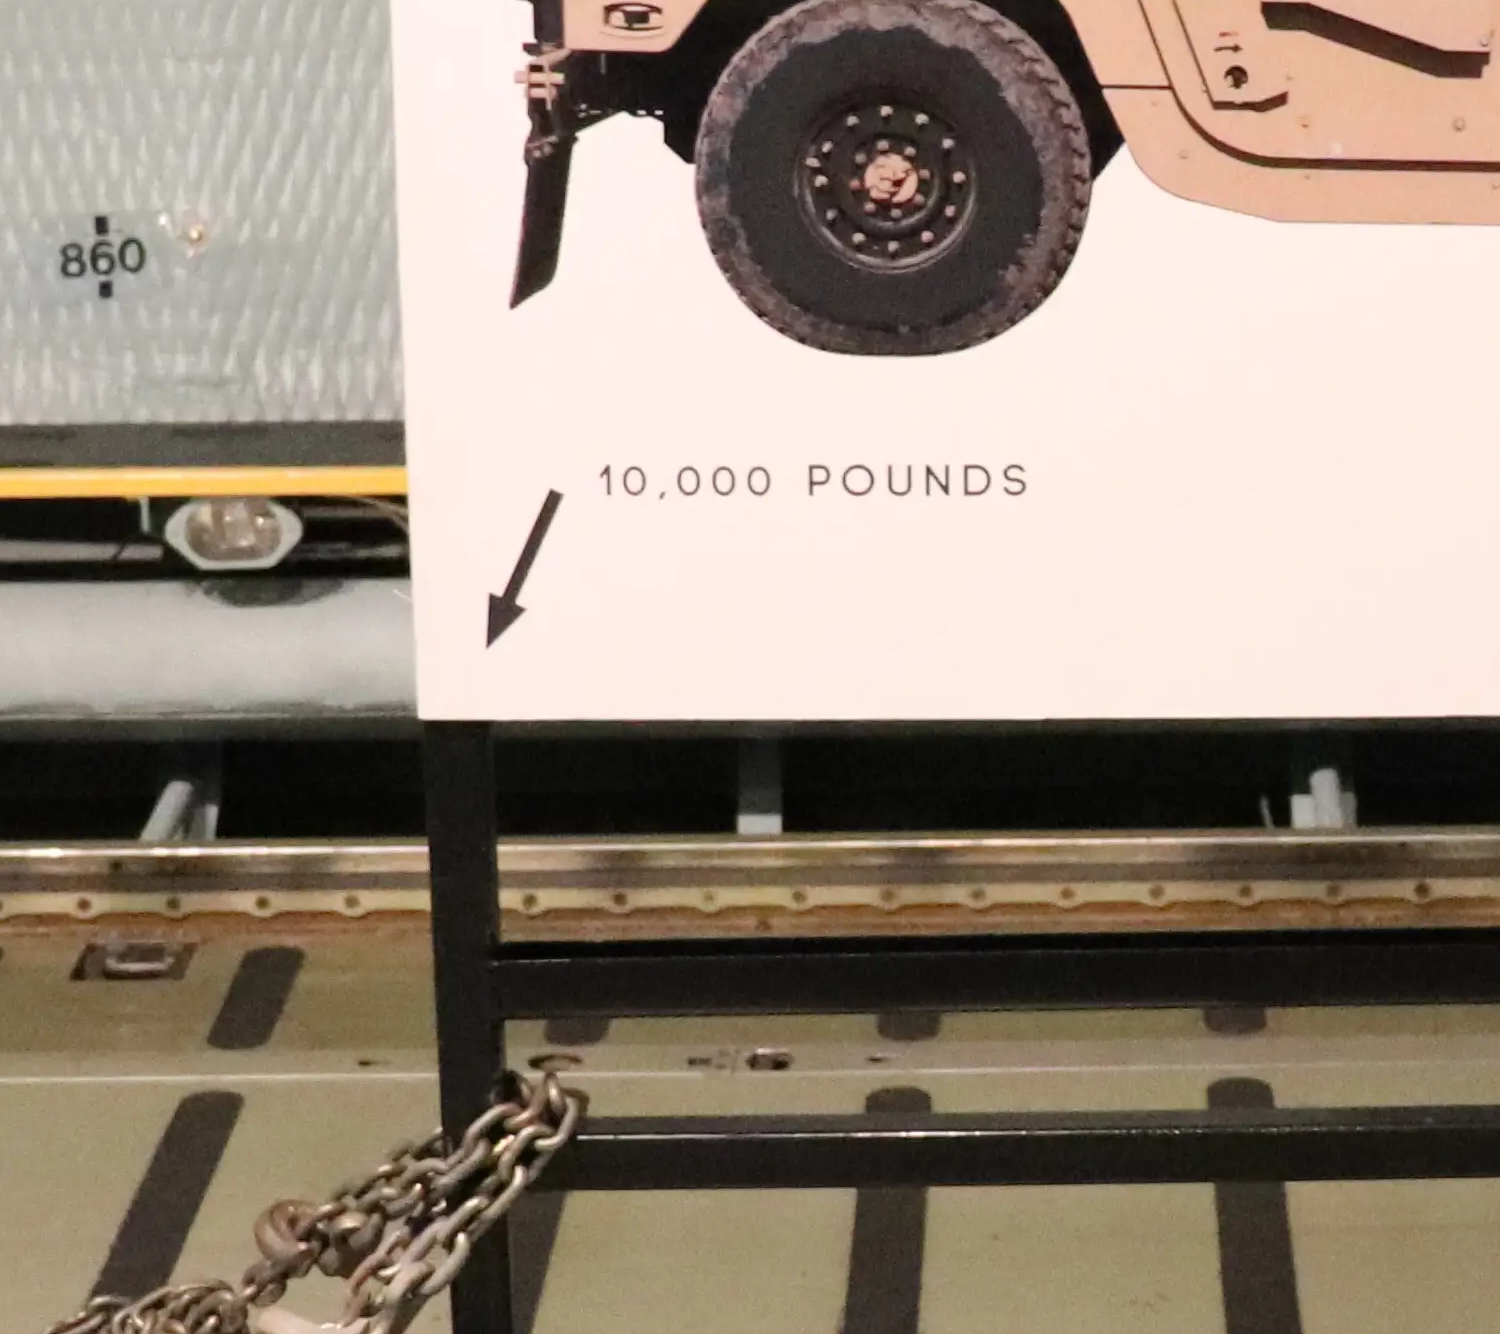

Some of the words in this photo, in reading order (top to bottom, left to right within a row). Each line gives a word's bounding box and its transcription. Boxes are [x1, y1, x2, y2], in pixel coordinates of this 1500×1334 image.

[60, 237, 145, 278] 860
[599, 464, 772, 500] 10,000
[807, 463, 1028, 497] POUNDS
